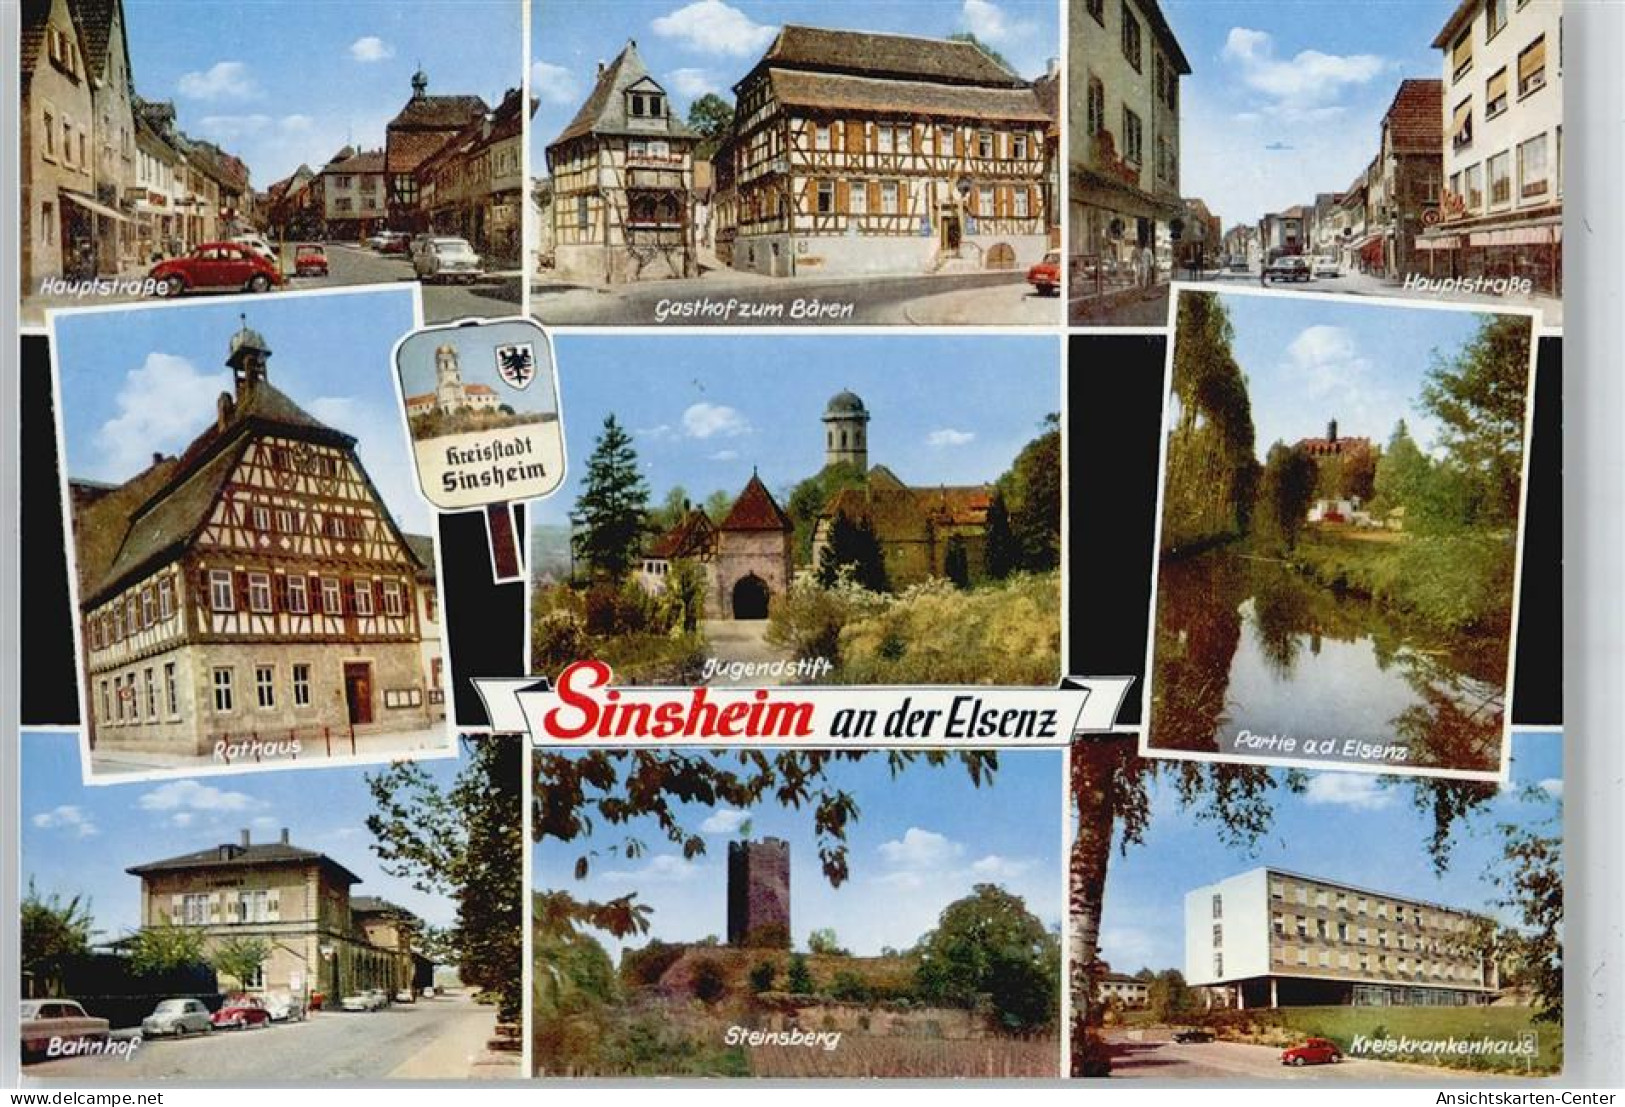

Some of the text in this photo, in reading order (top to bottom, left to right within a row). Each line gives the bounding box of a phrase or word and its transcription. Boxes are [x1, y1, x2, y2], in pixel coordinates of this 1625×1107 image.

[442, 461, 546, 492] Sinsheim
[543, 660, 1057, 739] Sinsheim an der Elsenz
